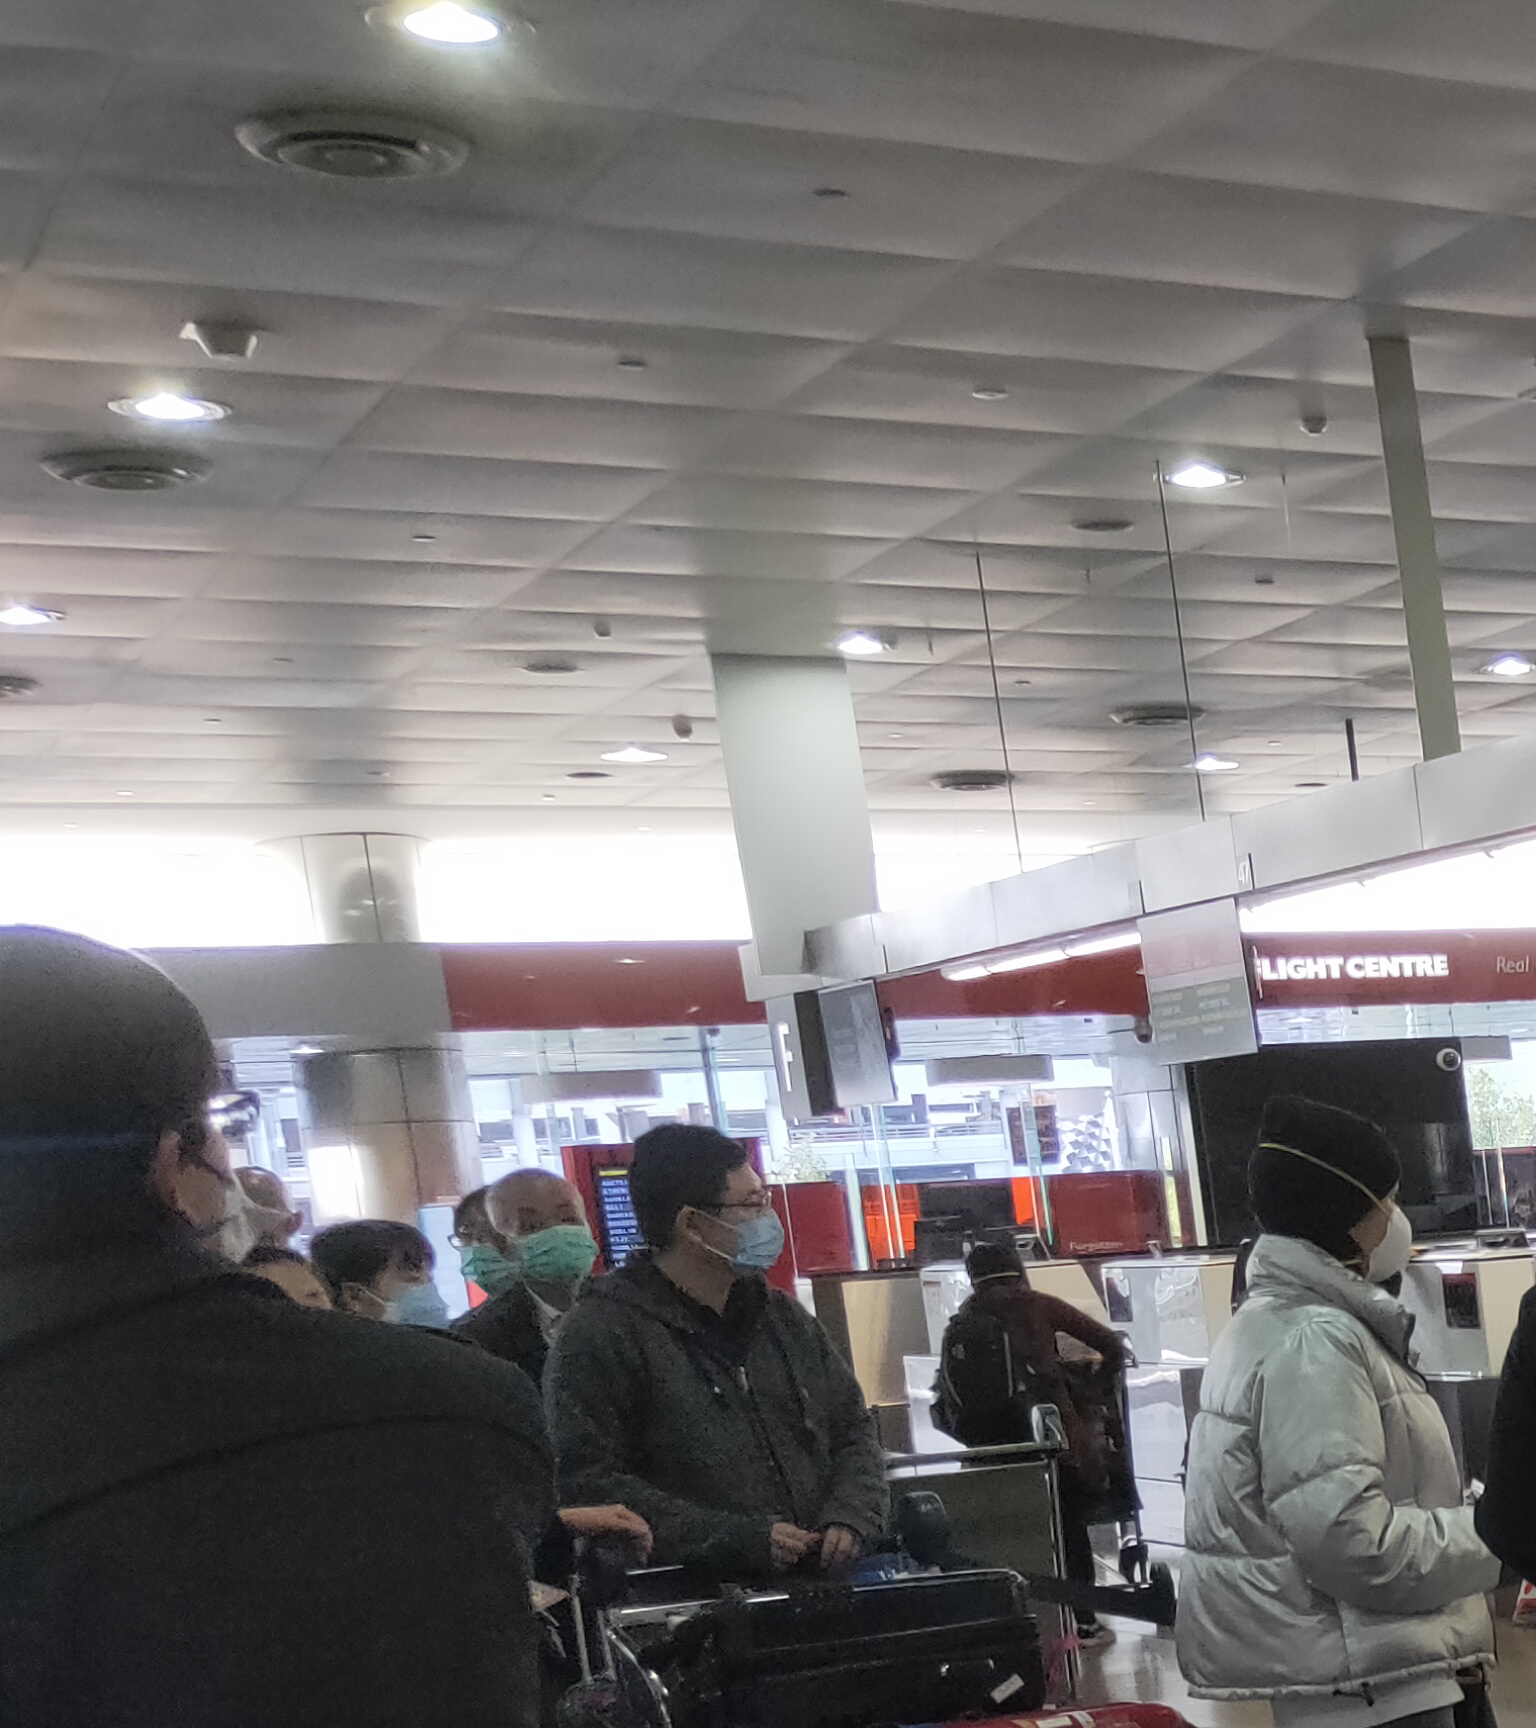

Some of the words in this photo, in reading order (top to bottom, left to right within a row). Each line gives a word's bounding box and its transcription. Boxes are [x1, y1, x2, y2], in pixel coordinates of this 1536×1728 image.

[1238, 862, 1250, 884] 47
[1346, 954, 1450, 978] CENTRE
[1497, 956, 1530, 974] Real
[778, 1022, 793, 1092] F
